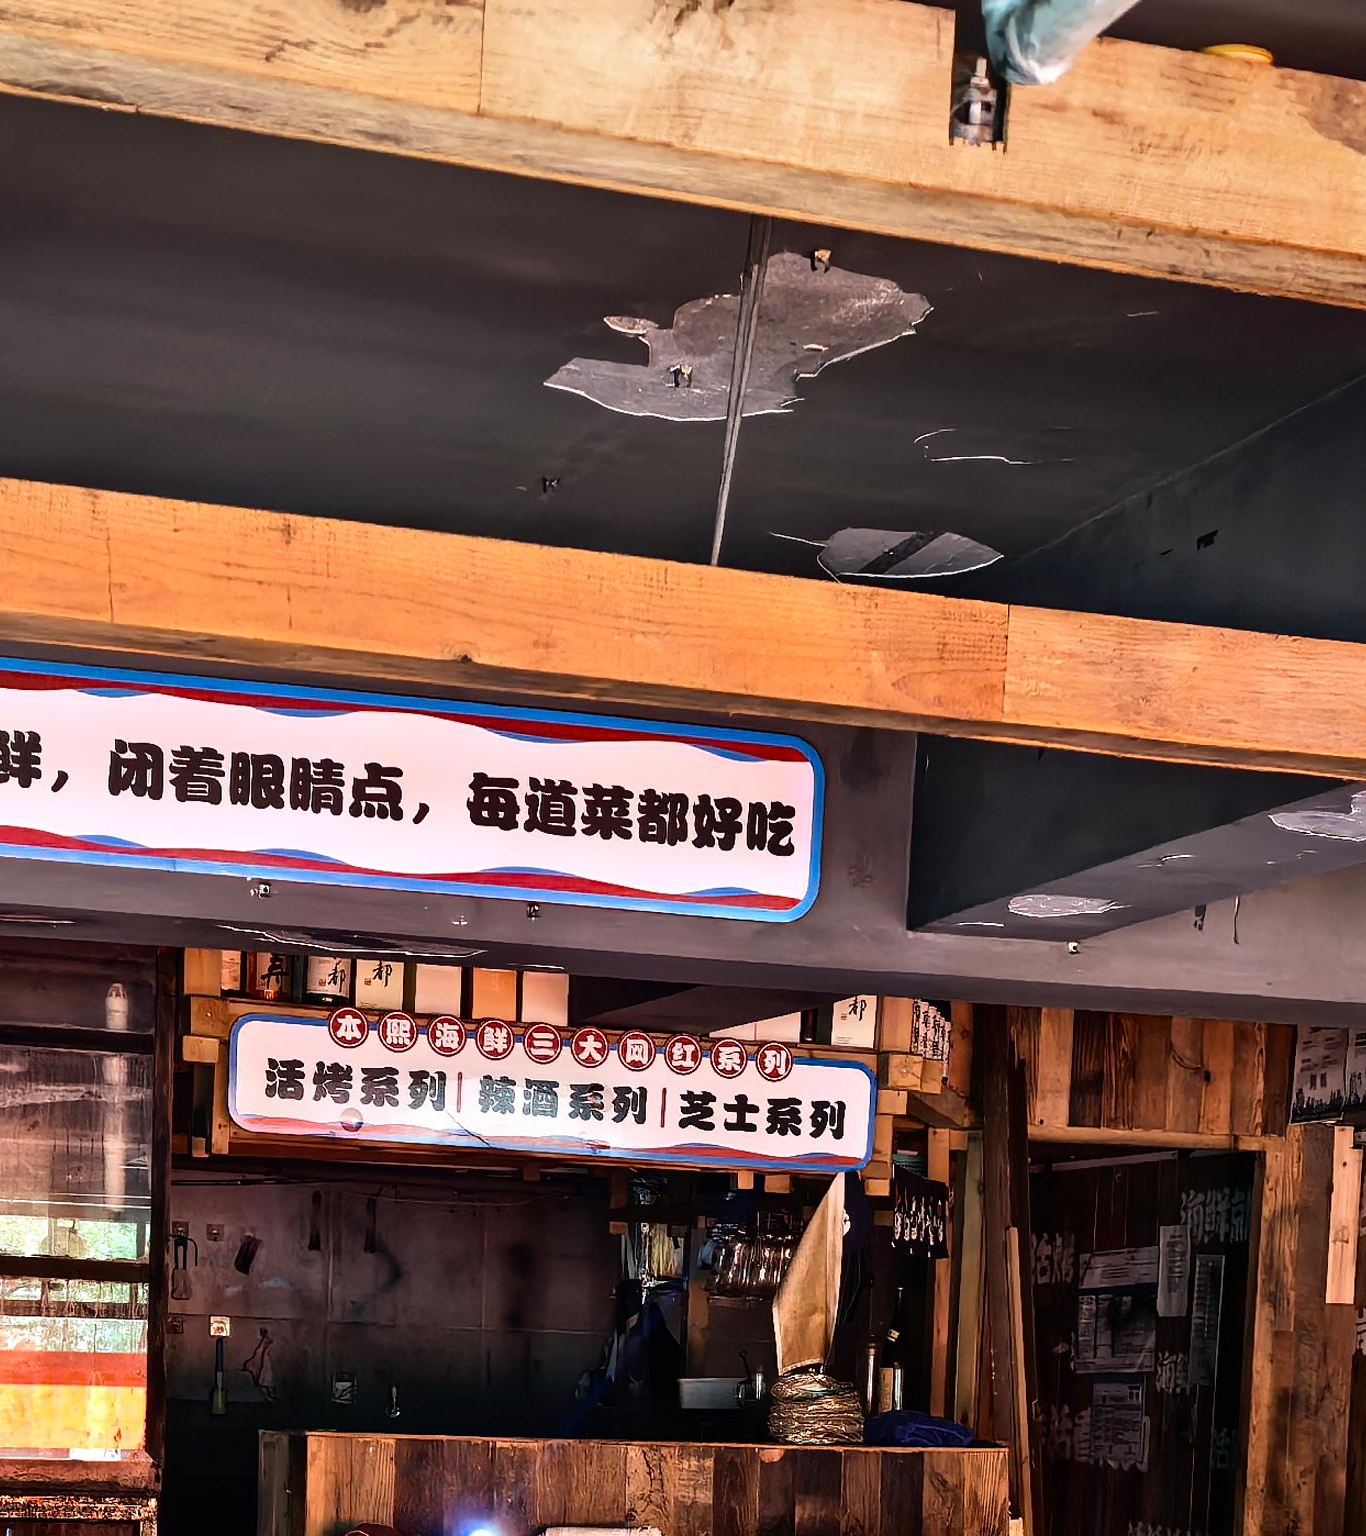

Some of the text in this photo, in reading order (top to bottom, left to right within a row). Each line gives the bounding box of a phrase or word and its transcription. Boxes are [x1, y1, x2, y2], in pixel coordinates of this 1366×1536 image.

[335, 1015, 789, 1077] 本熙海鲜三大网红系列
[265, 1057, 848, 1140] 活烤系列 辣酒系列 芝士系列
